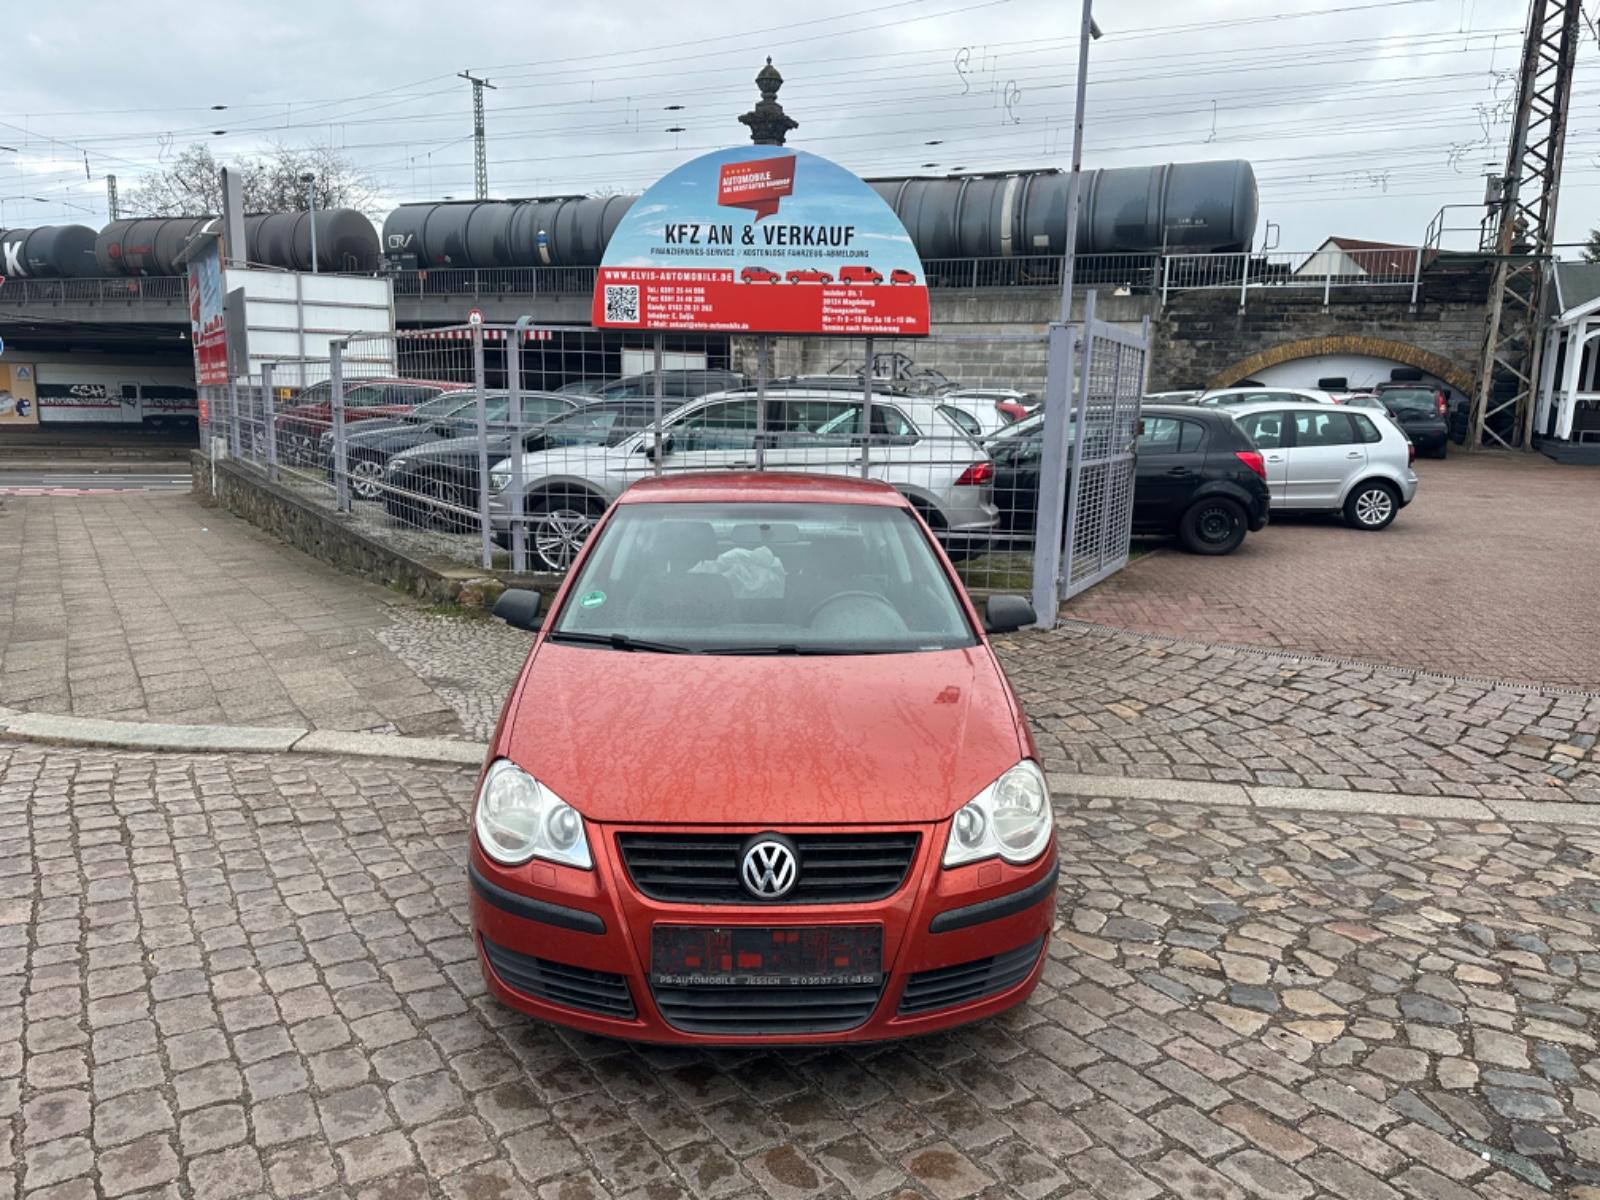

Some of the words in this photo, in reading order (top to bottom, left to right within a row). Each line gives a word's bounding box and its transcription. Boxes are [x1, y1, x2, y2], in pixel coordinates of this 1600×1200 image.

[723, 171, 771, 186] AUTOMOBILE
[665, 224, 700, 244] KFZ
[708, 225, 732, 245] AN
[741, 224, 754, 245] &
[763, 225, 855, 246] VERKAUF
[743, 249, 786, 257] KOSTENLOSE
[604, 271, 732, 282] WWW.ELVIS-AUTOMOBILE.DE
[660, 976, 736, 984] PS-AUTOMOBILE
[745, 977, 780, 985] JESSEN
